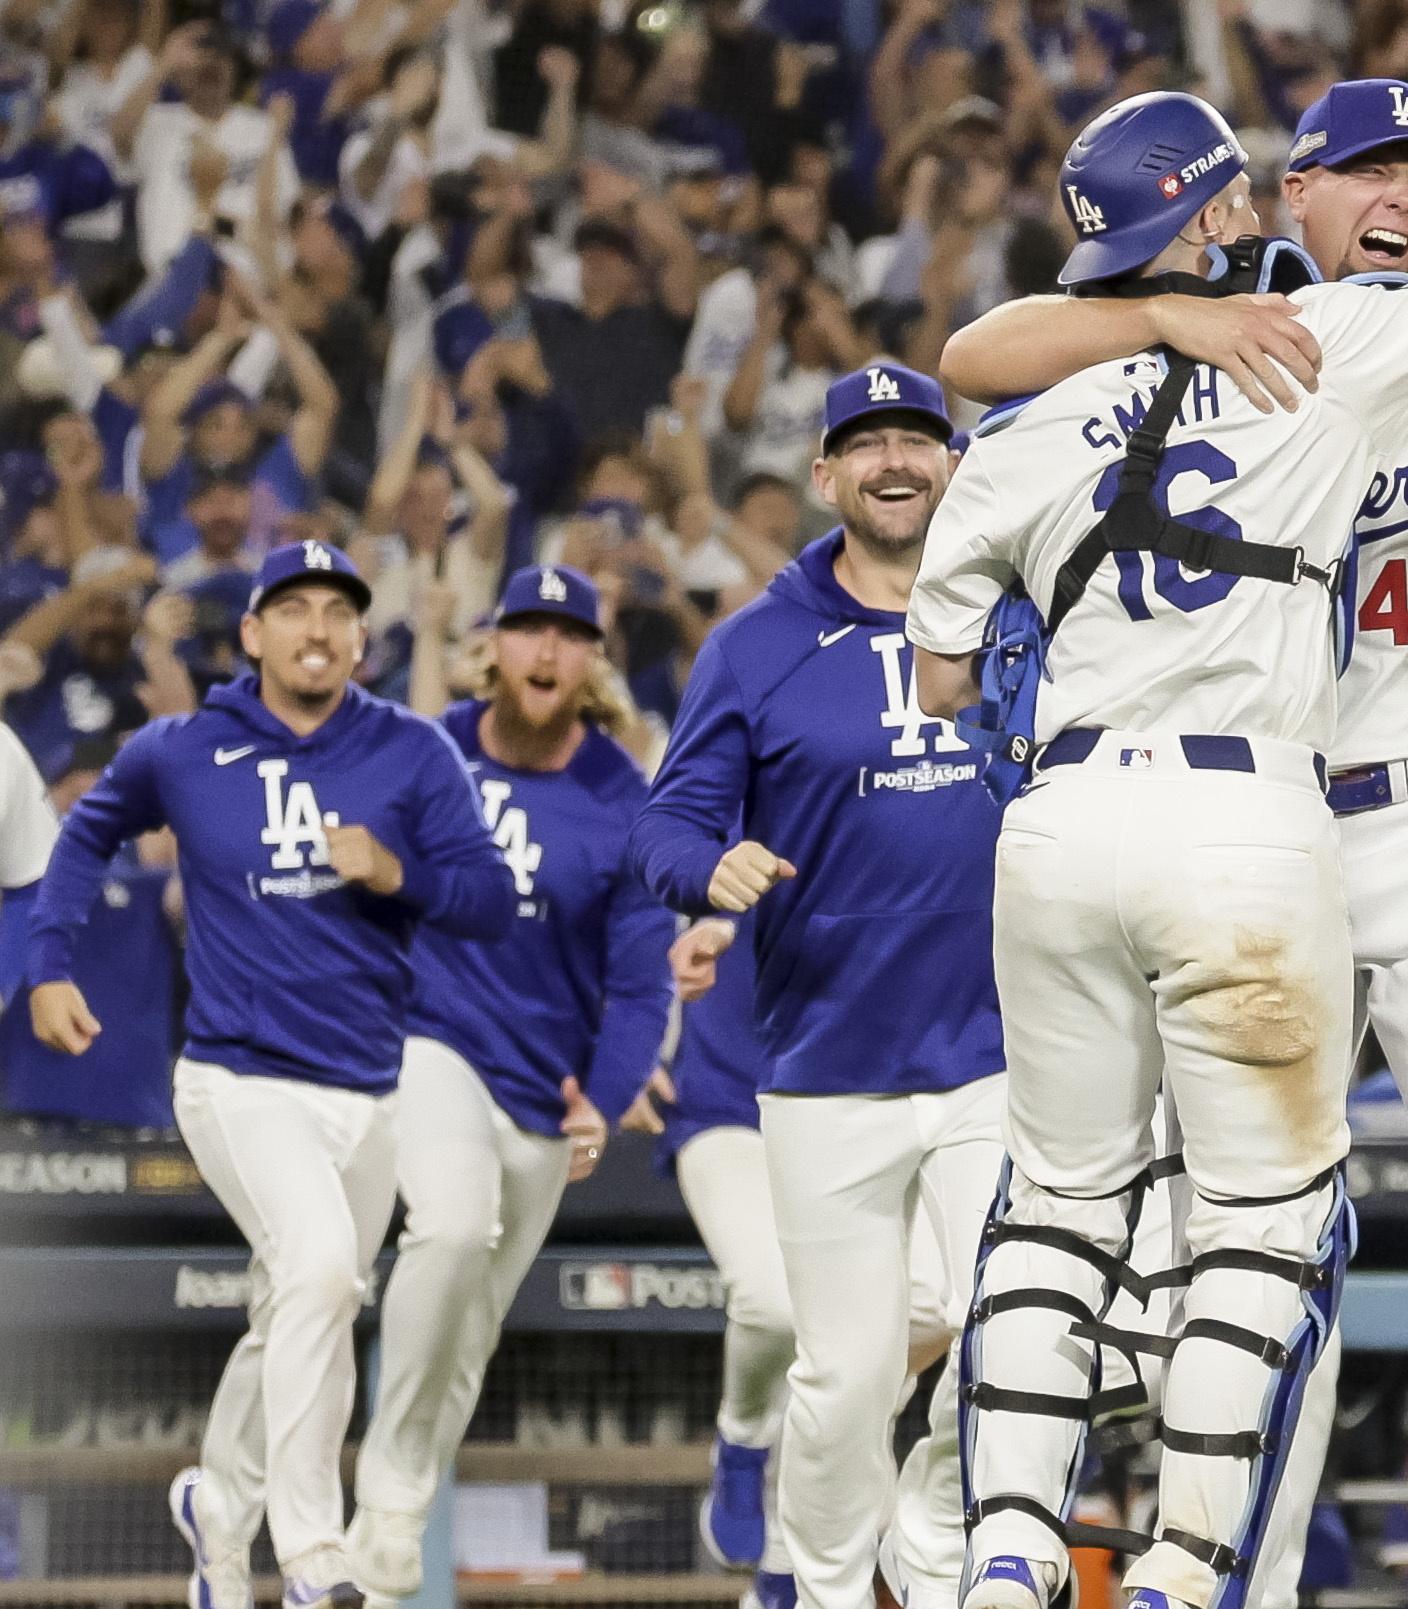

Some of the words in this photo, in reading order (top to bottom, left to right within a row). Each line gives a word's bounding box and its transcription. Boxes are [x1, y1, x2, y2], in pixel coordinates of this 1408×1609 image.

[1066, 185, 1107, 233] LA
[867, 368, 901, 401] LA
[302, 539, 332, 570] LA
[539, 567, 566, 602] LA
[874, 764, 976, 789] POSTSEASON
[257, 759, 339, 869] LA
